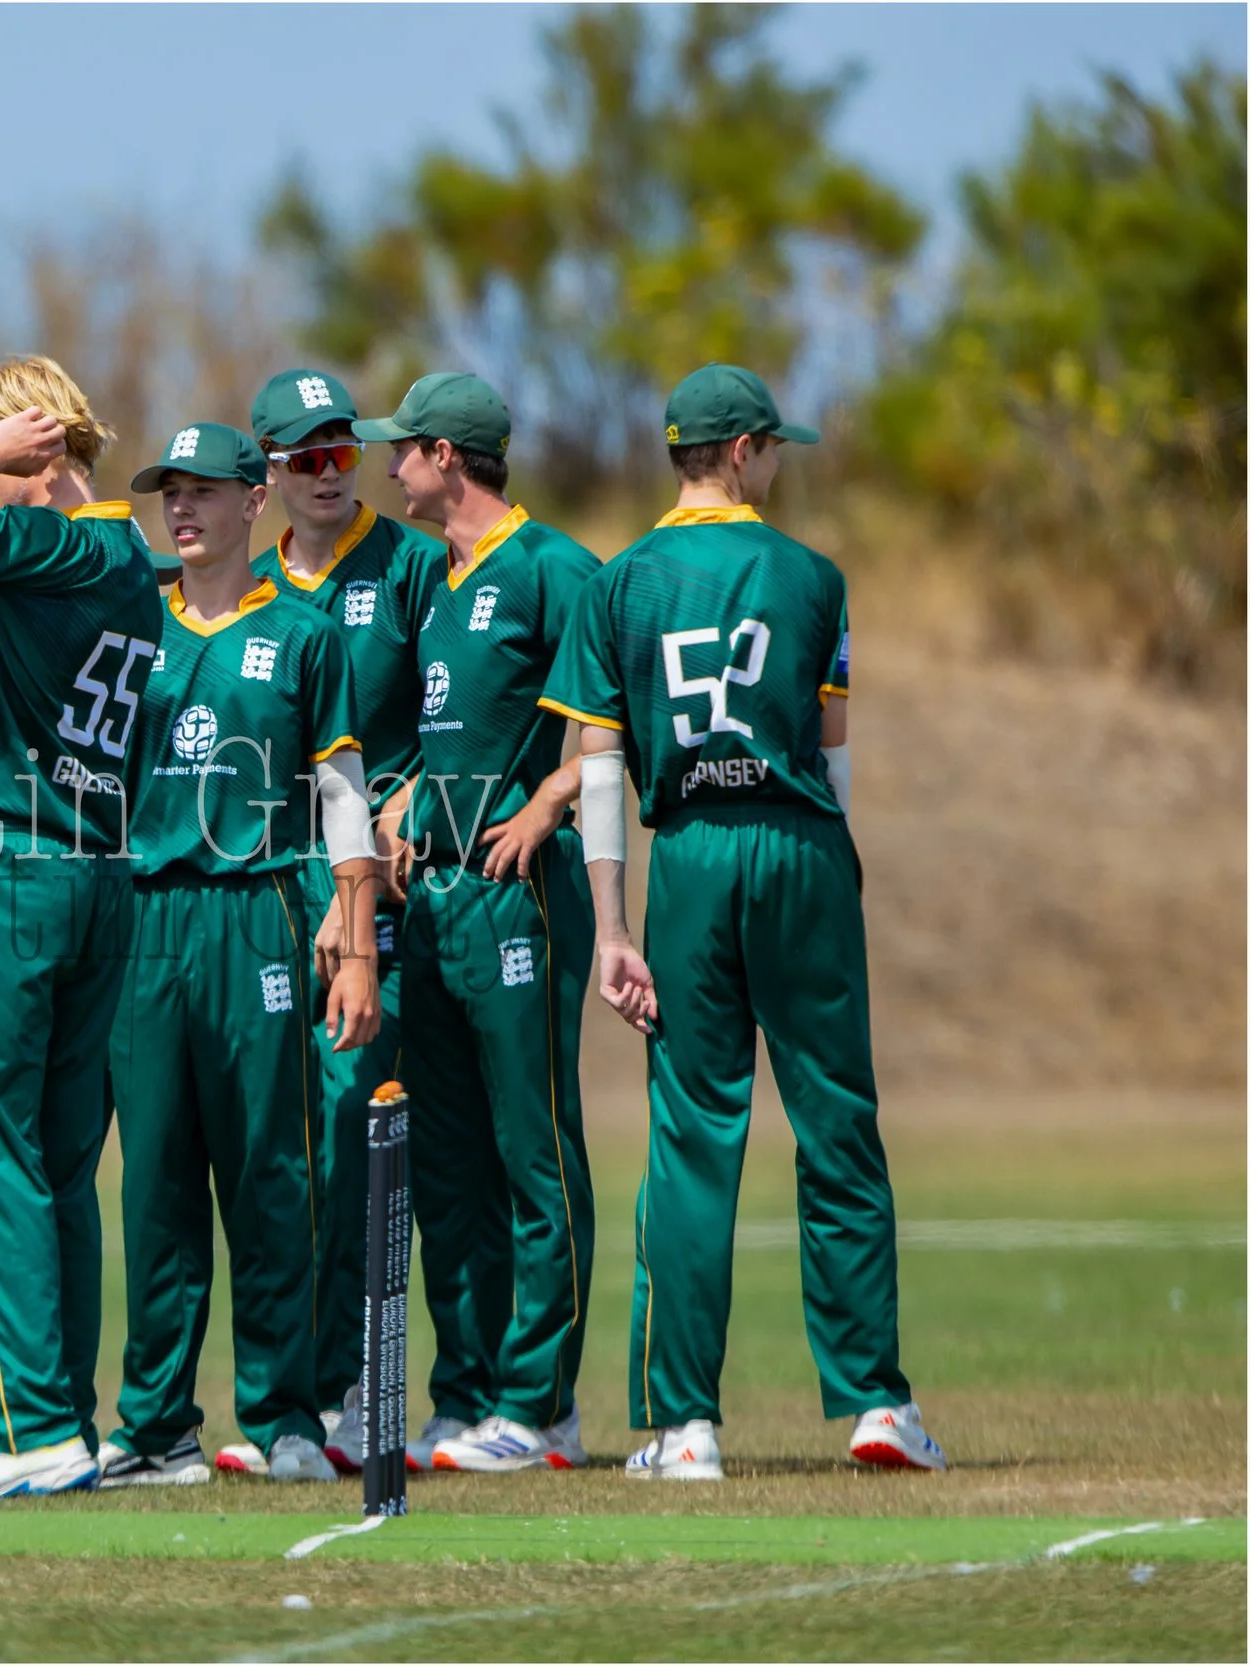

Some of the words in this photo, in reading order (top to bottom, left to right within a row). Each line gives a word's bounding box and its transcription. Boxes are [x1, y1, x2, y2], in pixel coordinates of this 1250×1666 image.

[57, 630, 156, 759] 55
[661, 619, 771, 748] 52
[152, 766, 191, 776] marter
